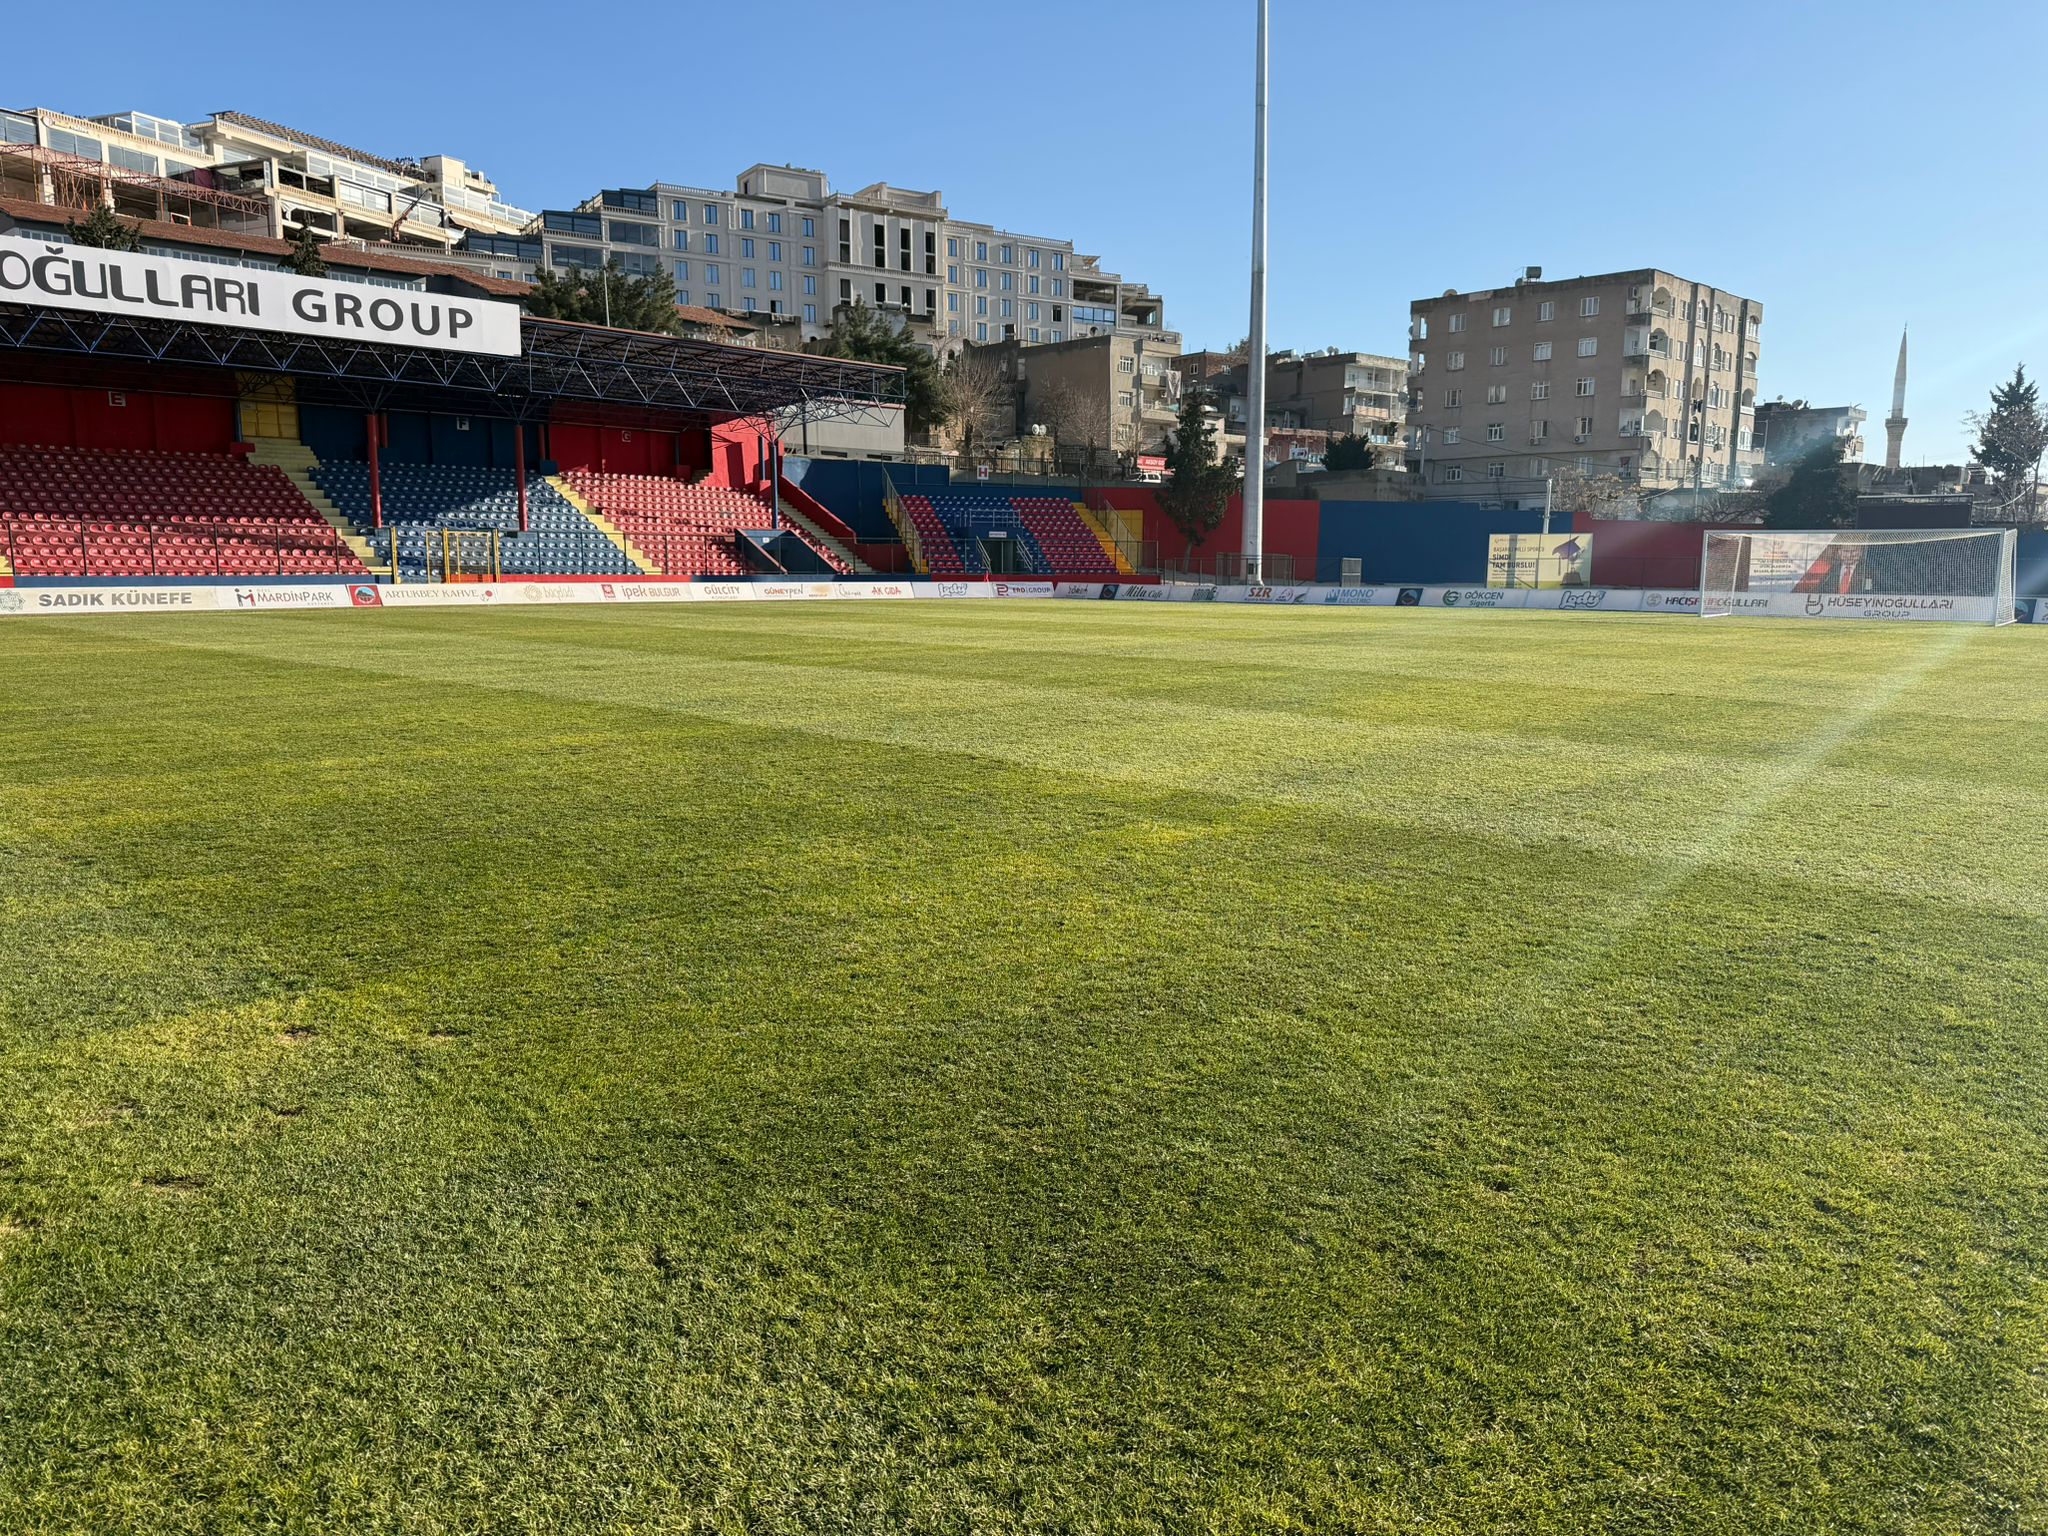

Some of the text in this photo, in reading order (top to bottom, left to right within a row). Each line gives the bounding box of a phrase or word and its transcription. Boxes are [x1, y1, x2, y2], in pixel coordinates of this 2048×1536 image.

[0, 245, 473, 338] OĞULLARI GROUP
[979, 467, 988, 478] H
[257, 590, 334, 602] MARDİNPARK
[385, 589, 479, 599] ARTUKBEY KAHVE
[1248, 587, 1273, 598] SZR
[1340, 589, 1374, 598] MONO
[39, 590, 192, 607] SADIK KÜNEFE
[1827, 595, 1953, 610] HÜSEYİNOĞULLARI
[1864, 610, 1911, 618] GROUP
